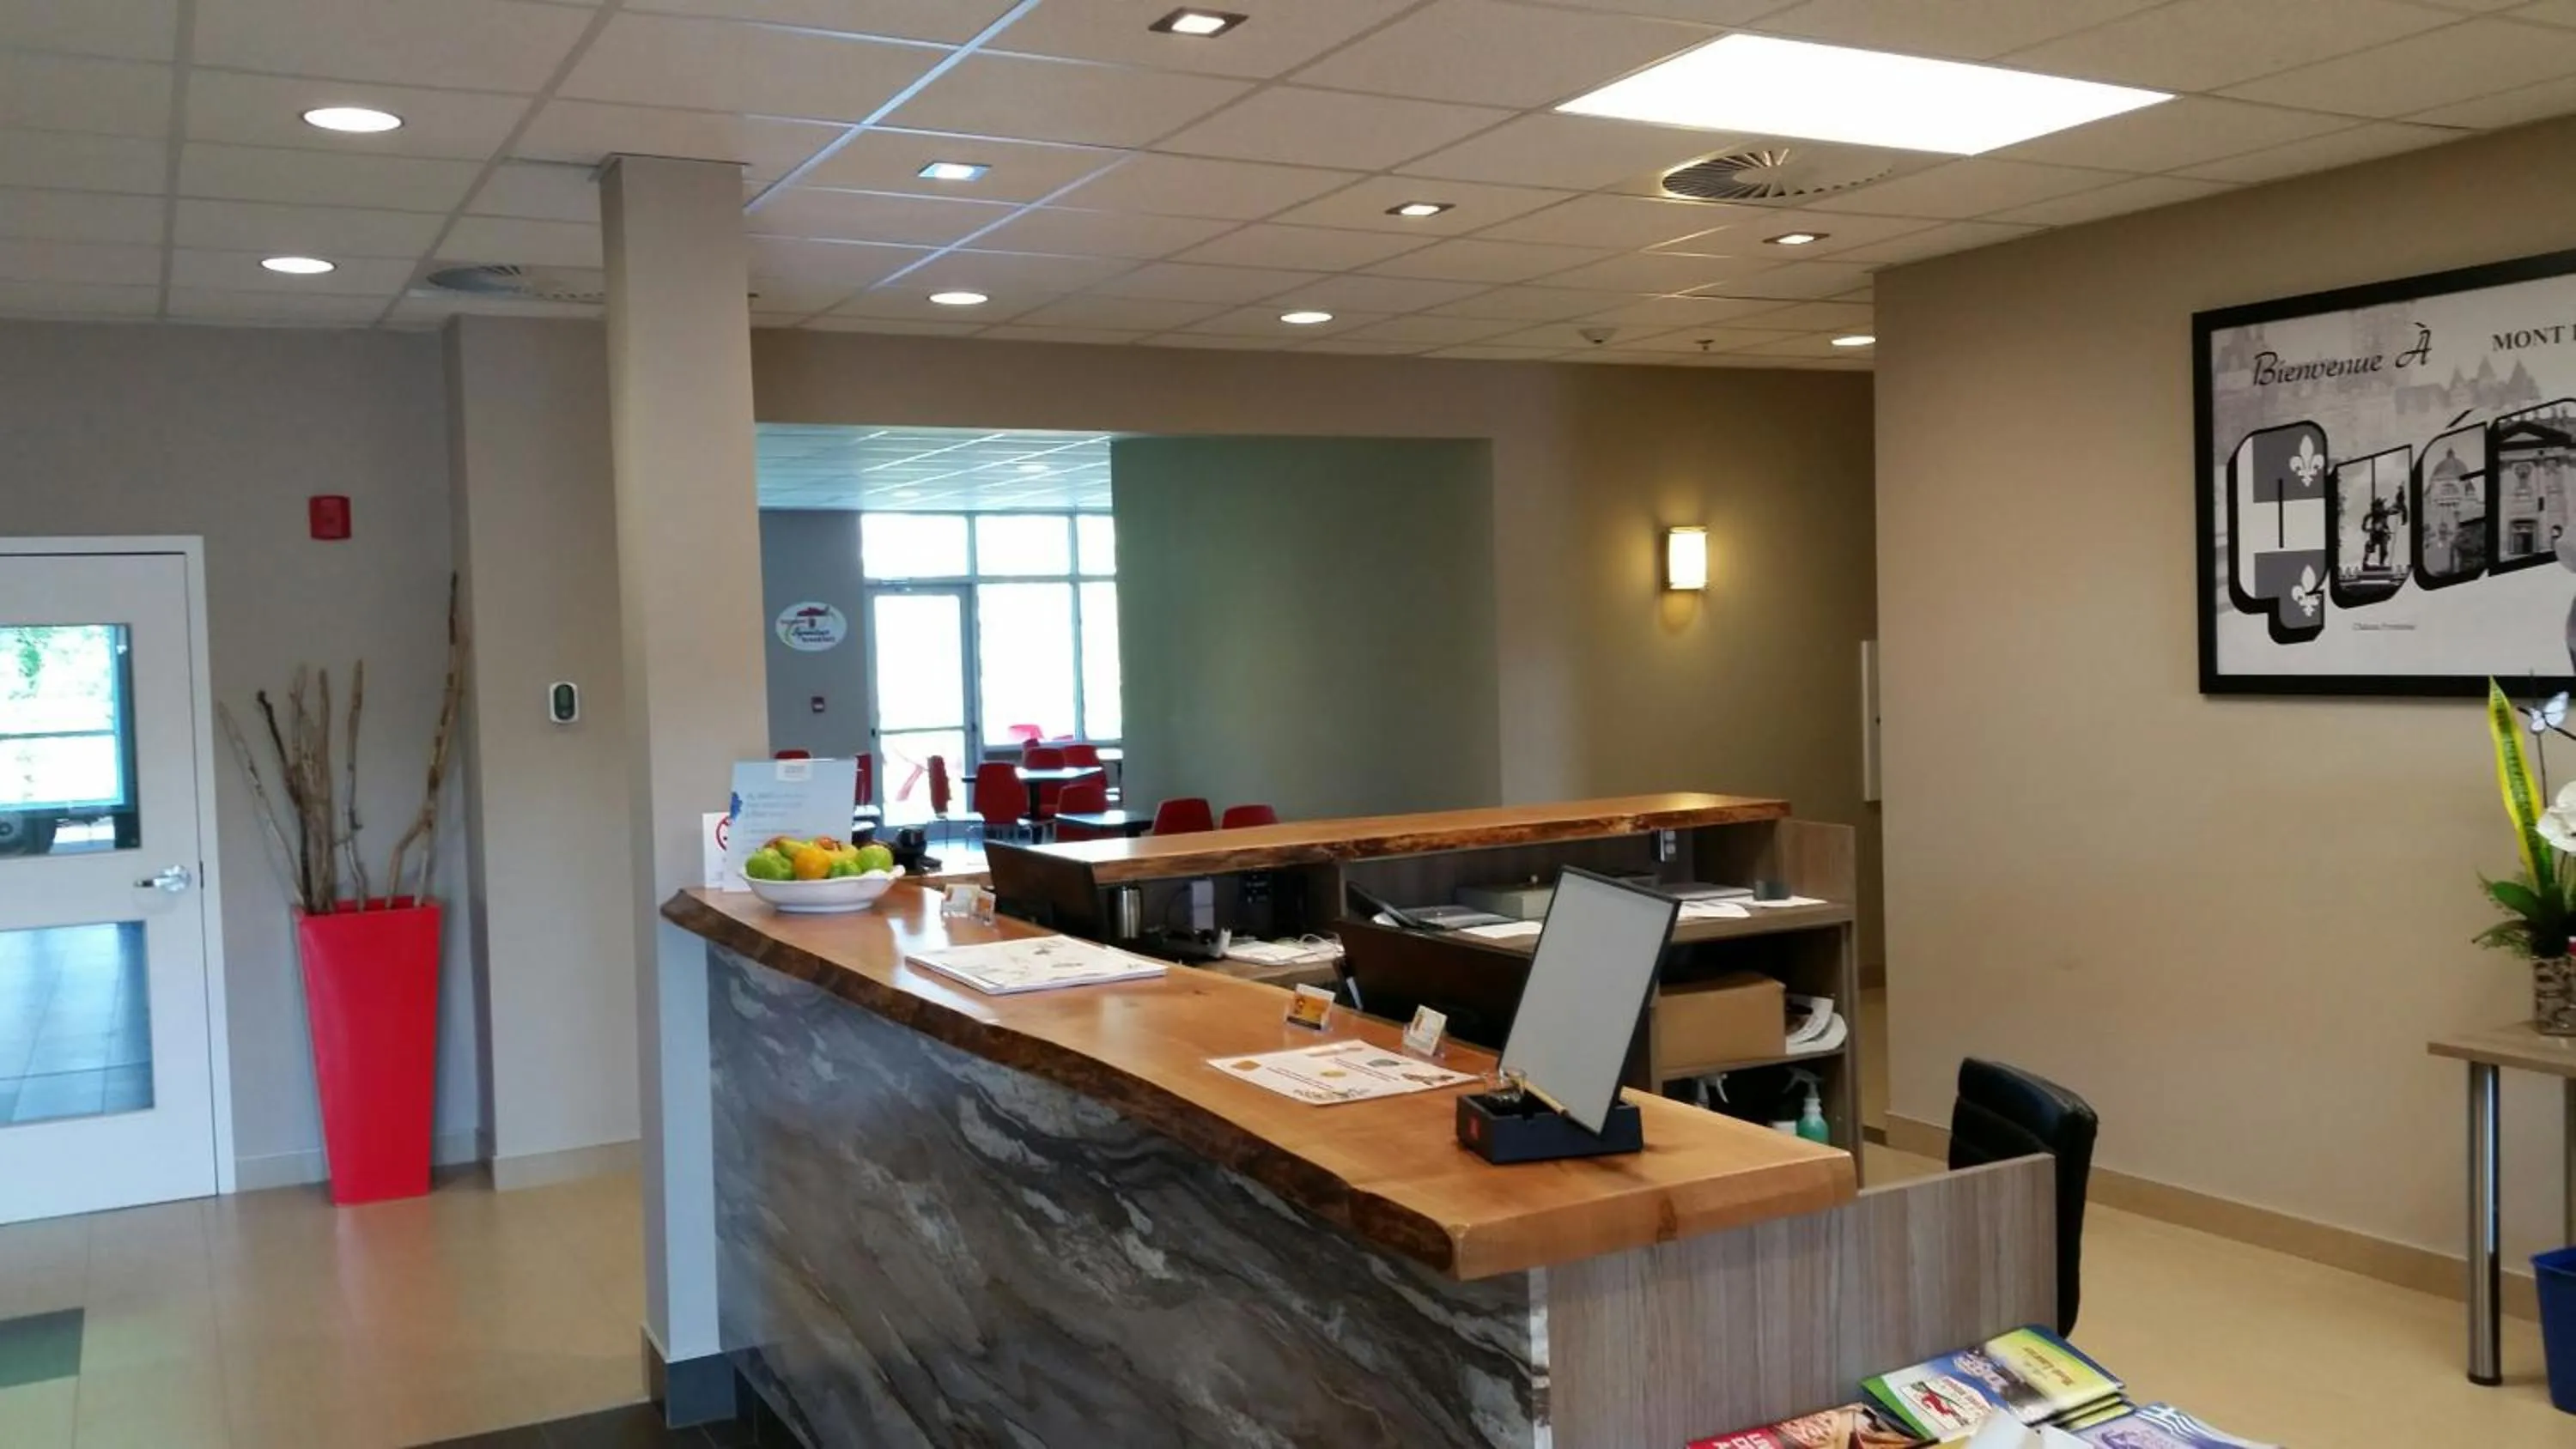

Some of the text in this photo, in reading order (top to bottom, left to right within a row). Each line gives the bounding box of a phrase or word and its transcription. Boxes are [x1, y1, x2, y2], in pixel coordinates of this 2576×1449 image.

[2252, 321, 2433, 386] Bienvenue À
[2492, 324, 2566, 352] MONT
